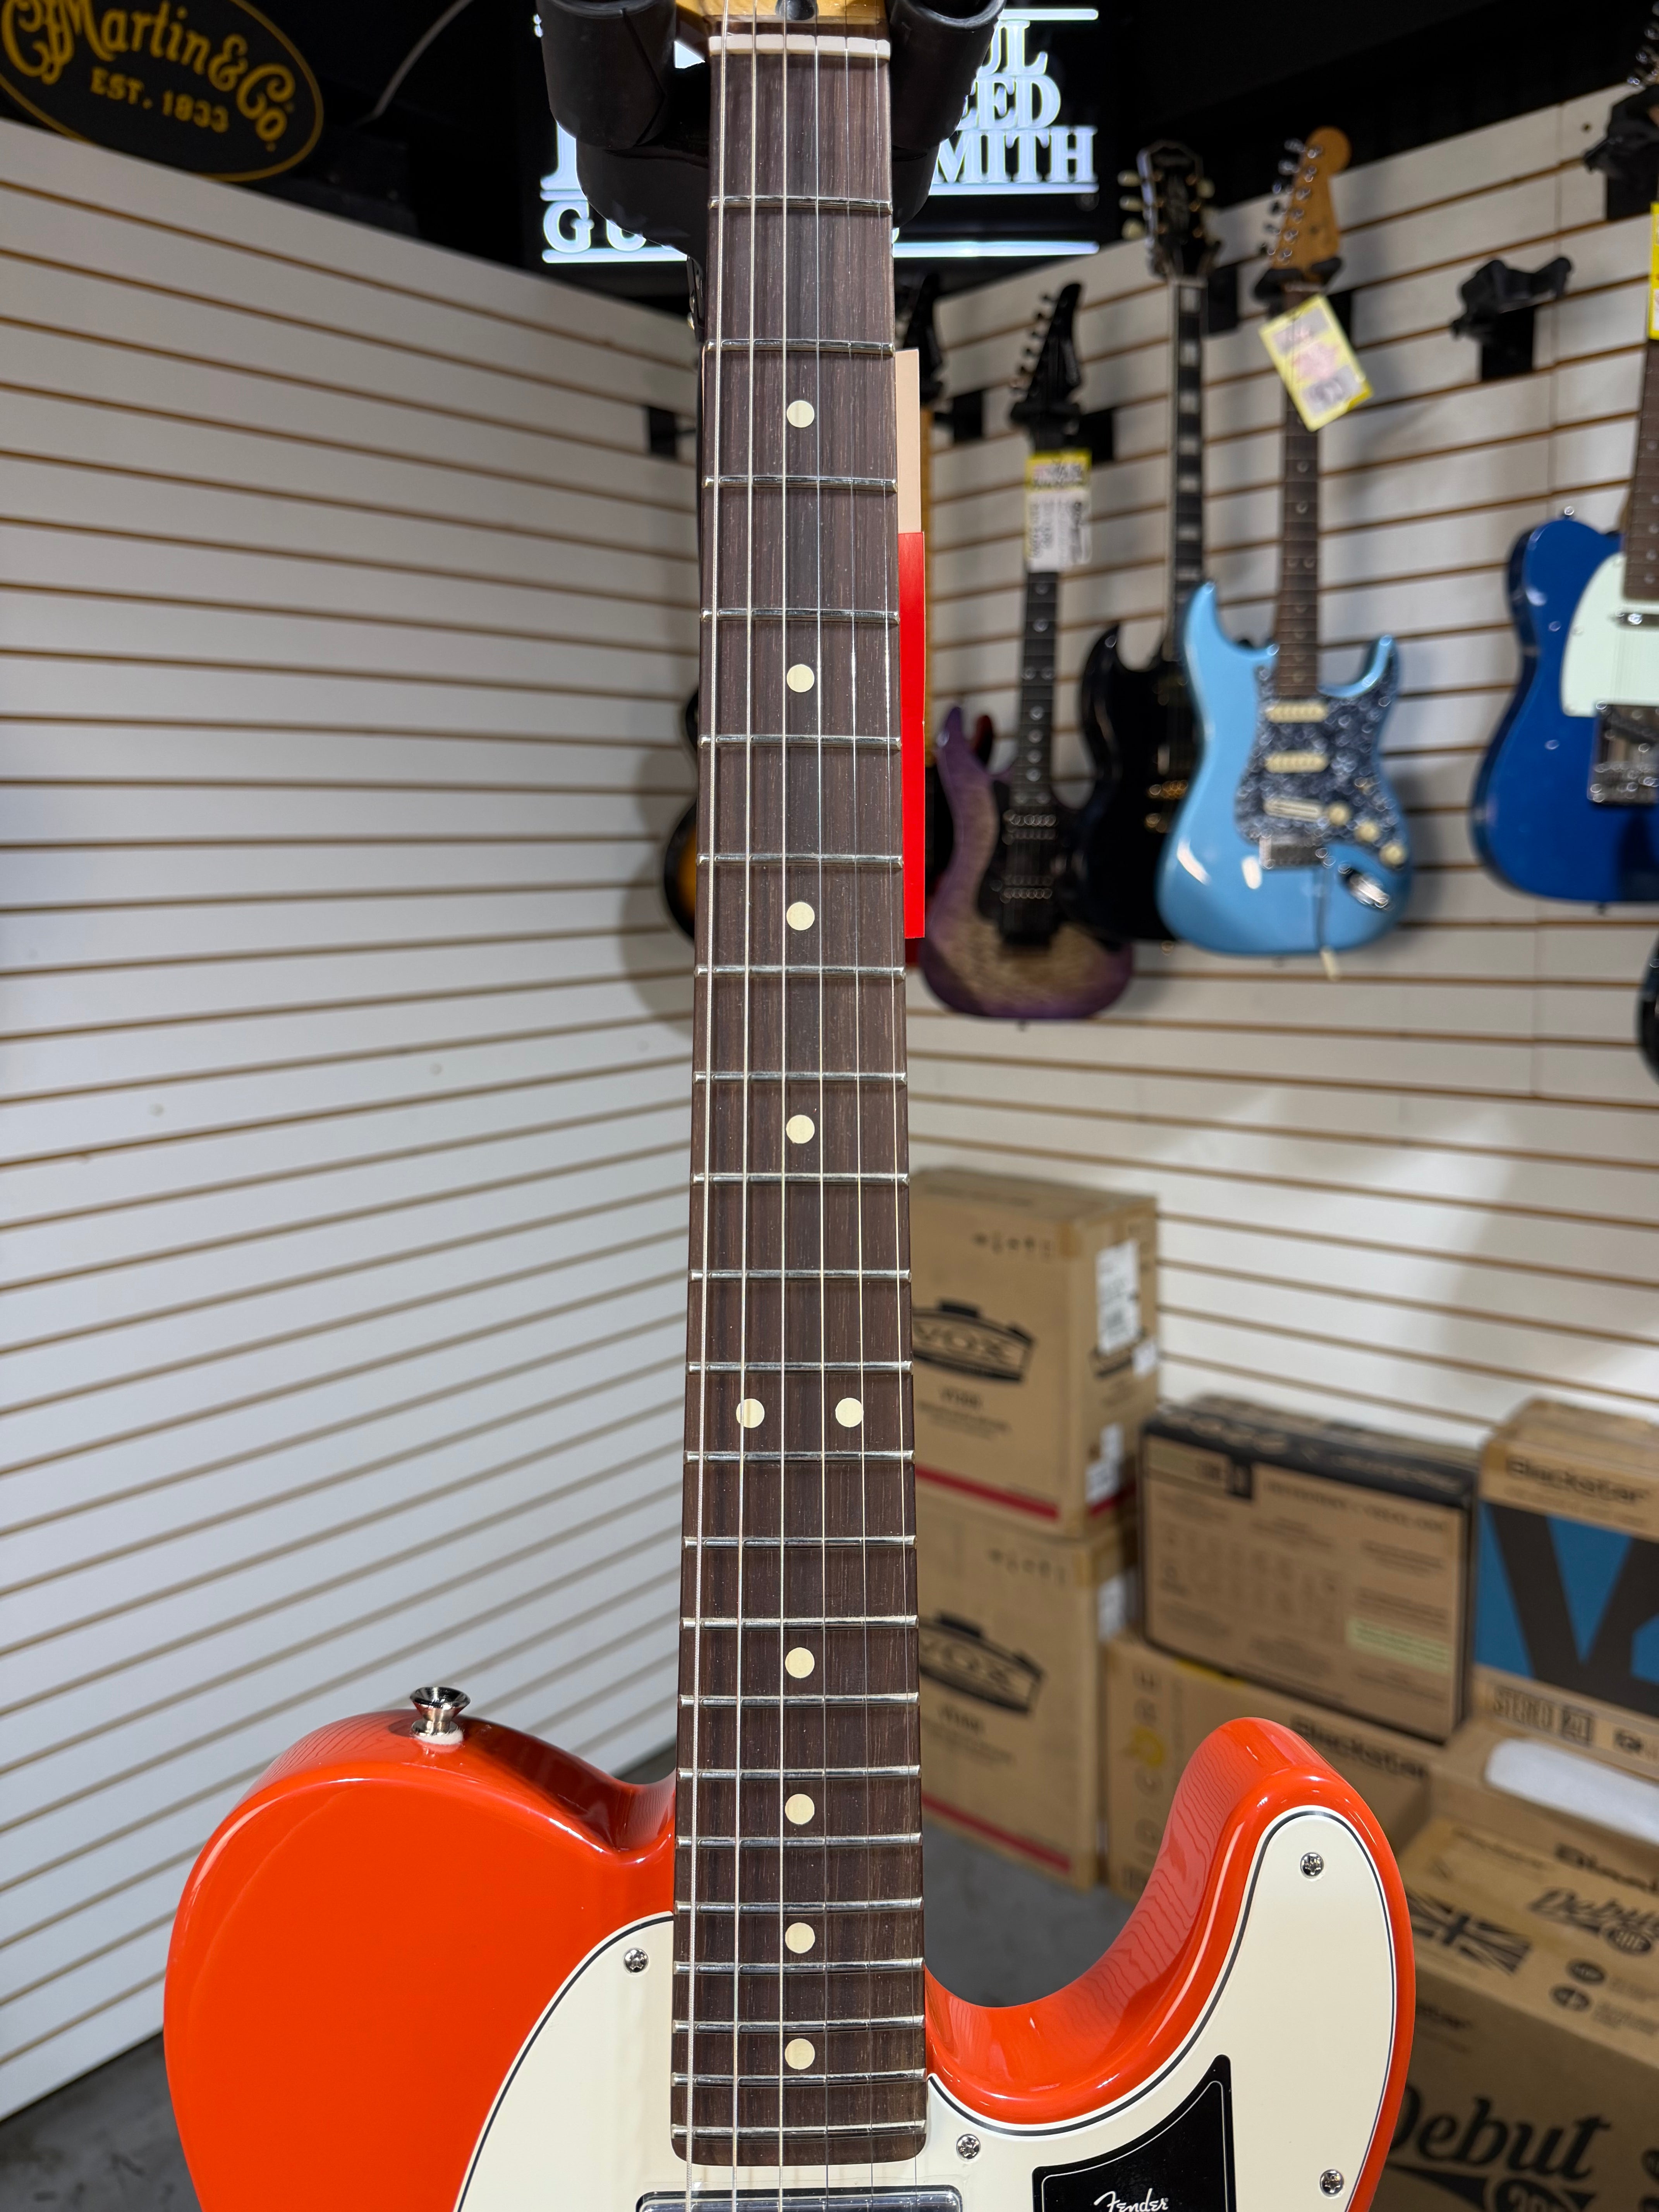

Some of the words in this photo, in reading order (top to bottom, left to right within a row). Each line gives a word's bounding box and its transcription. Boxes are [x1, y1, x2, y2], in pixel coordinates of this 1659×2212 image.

[90, 66, 152, 110] EST.
[162, 89, 229, 133] 1833
[1093, 2188, 1169, 2212] Fender
